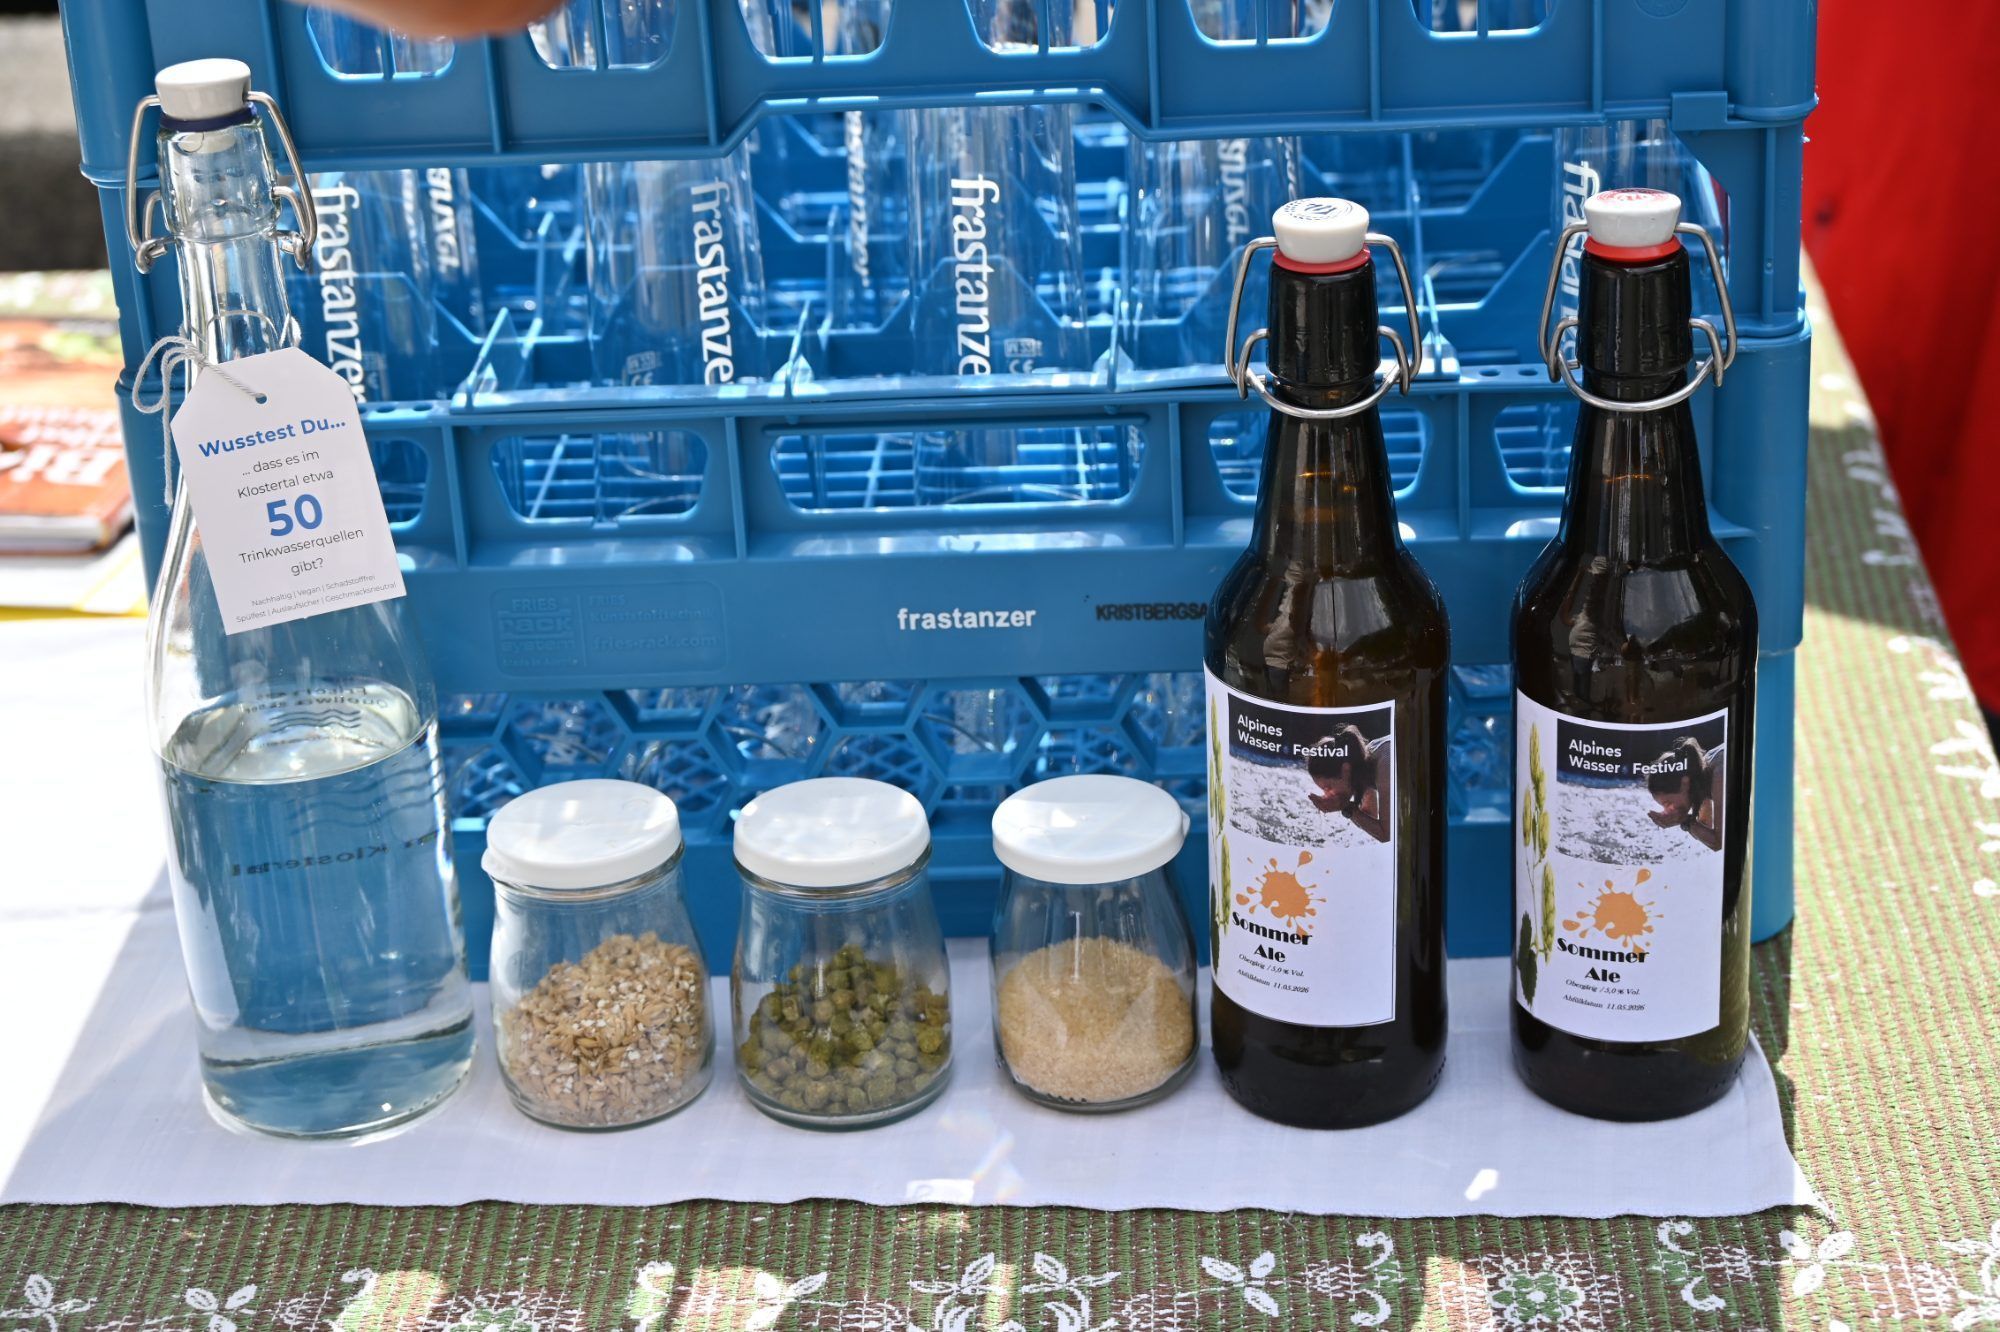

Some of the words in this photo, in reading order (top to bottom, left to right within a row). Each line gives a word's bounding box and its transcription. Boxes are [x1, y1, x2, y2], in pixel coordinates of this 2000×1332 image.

[690, 176, 735, 385] frastanze
[951, 174, 1000, 376] frastanze
[198, 424, 296, 457] Wusstest
[300, 418, 346, 434] Du...
[252, 457, 283, 473] dass
[285, 455, 300, 466] es
[302, 450, 320, 462] im
[237, 475, 299, 499] Klostertal
[302, 469, 334, 484] etwa
[266, 494, 323, 537] 50
[238, 528, 364, 565] Trinkwasserquellen
[290, 558, 324, 576] gibt?
[235, 610, 266, 623] Spülfest
[271, 599, 320, 615] Auslaufsicher
[324, 581, 397, 603] Geschmacksneutral
[251, 592, 293, 607] Nachhaltig
[297, 586, 321, 597] Vegan
[511, 596, 558, 612] FRIES
[498, 616, 574, 633] rack
[896, 606, 1036, 630] frastanzer
[1237, 714, 1283, 737] Alpines
[1238, 729, 1282, 753] Wasser
[1292, 743, 1349, 758] Festival
[1568, 739, 1622, 758] Alpines
[1568, 754, 1620, 774] Wasser
[1632, 759, 1688, 775] Festival
[1232, 911, 1313, 946] Sommer
[1253, 944, 1286, 963] Ale
[1556, 937, 1650, 963] Sommer
[1584, 967, 1621, 983] Ale
